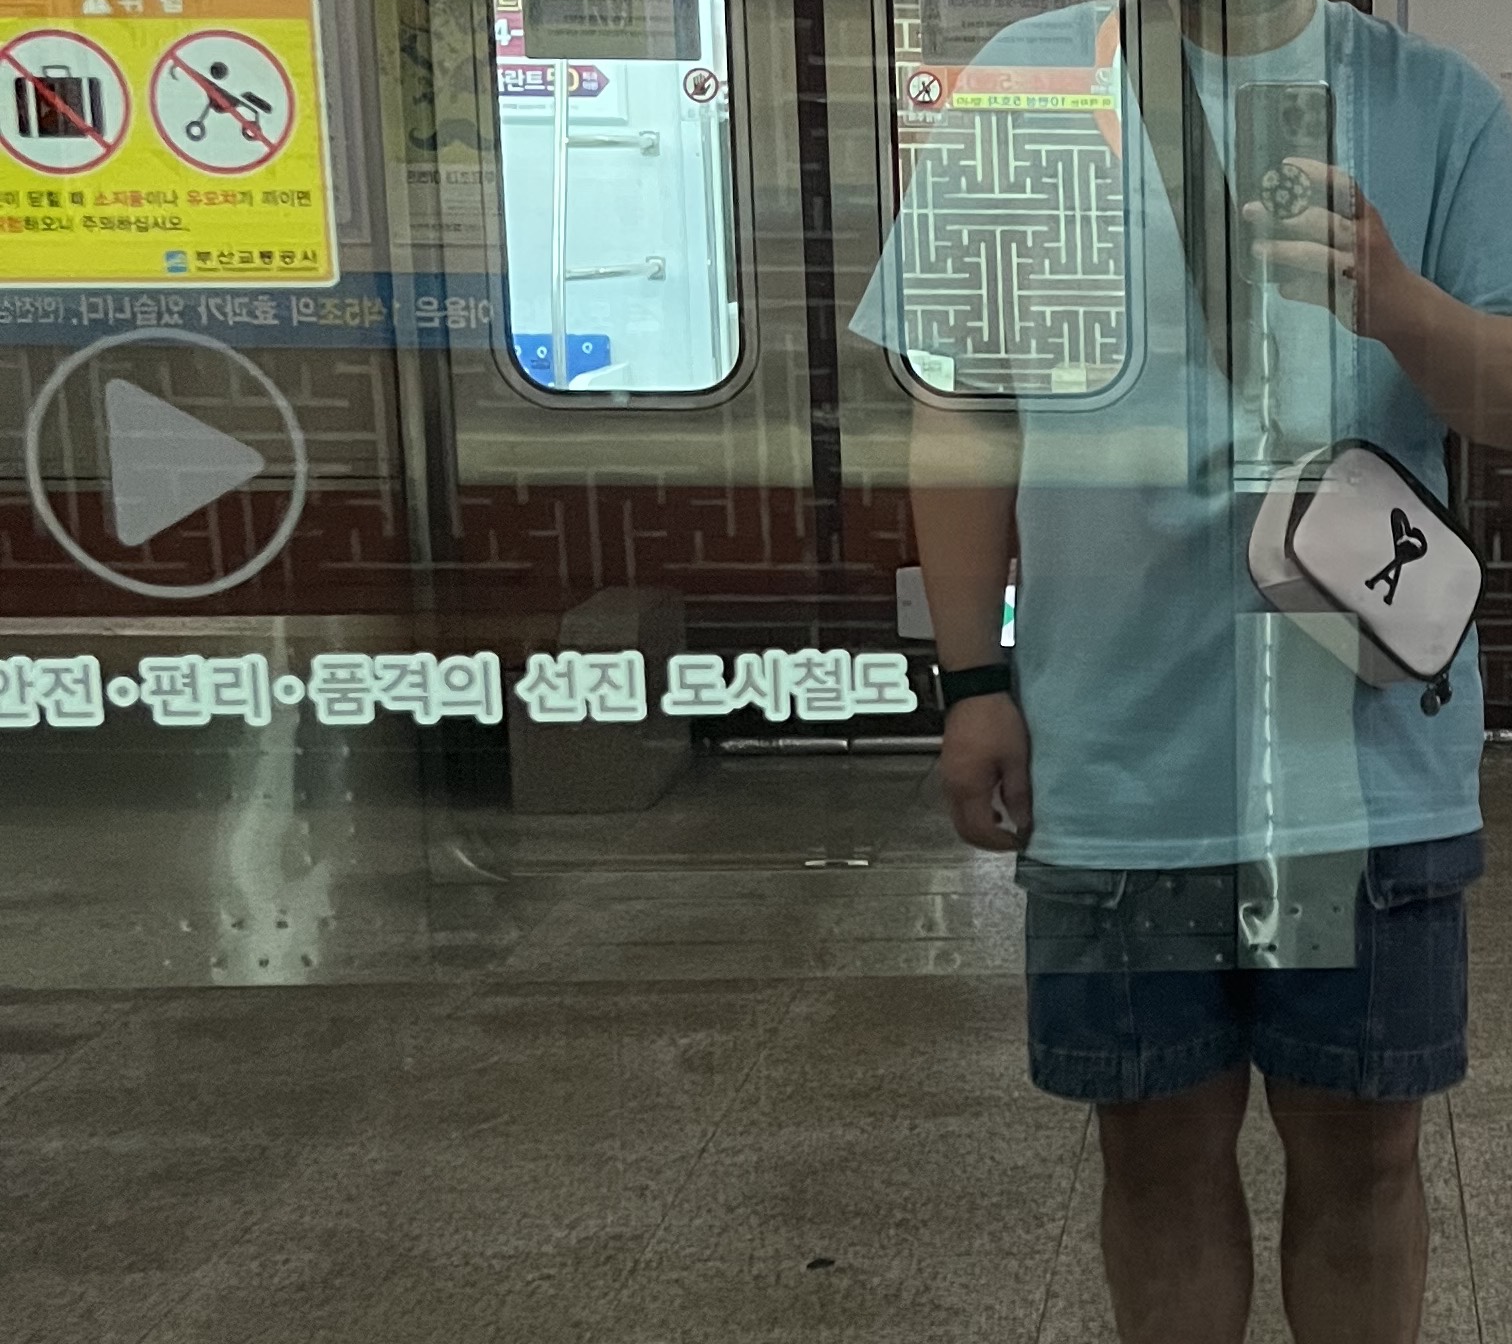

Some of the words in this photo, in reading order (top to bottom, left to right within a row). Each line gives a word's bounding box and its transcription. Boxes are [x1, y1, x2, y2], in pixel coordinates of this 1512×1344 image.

[195, 249, 319, 266] 부산교통공사
[516, 651, 647, 723] 선진
[662, 647, 919, 721] 도시철도
